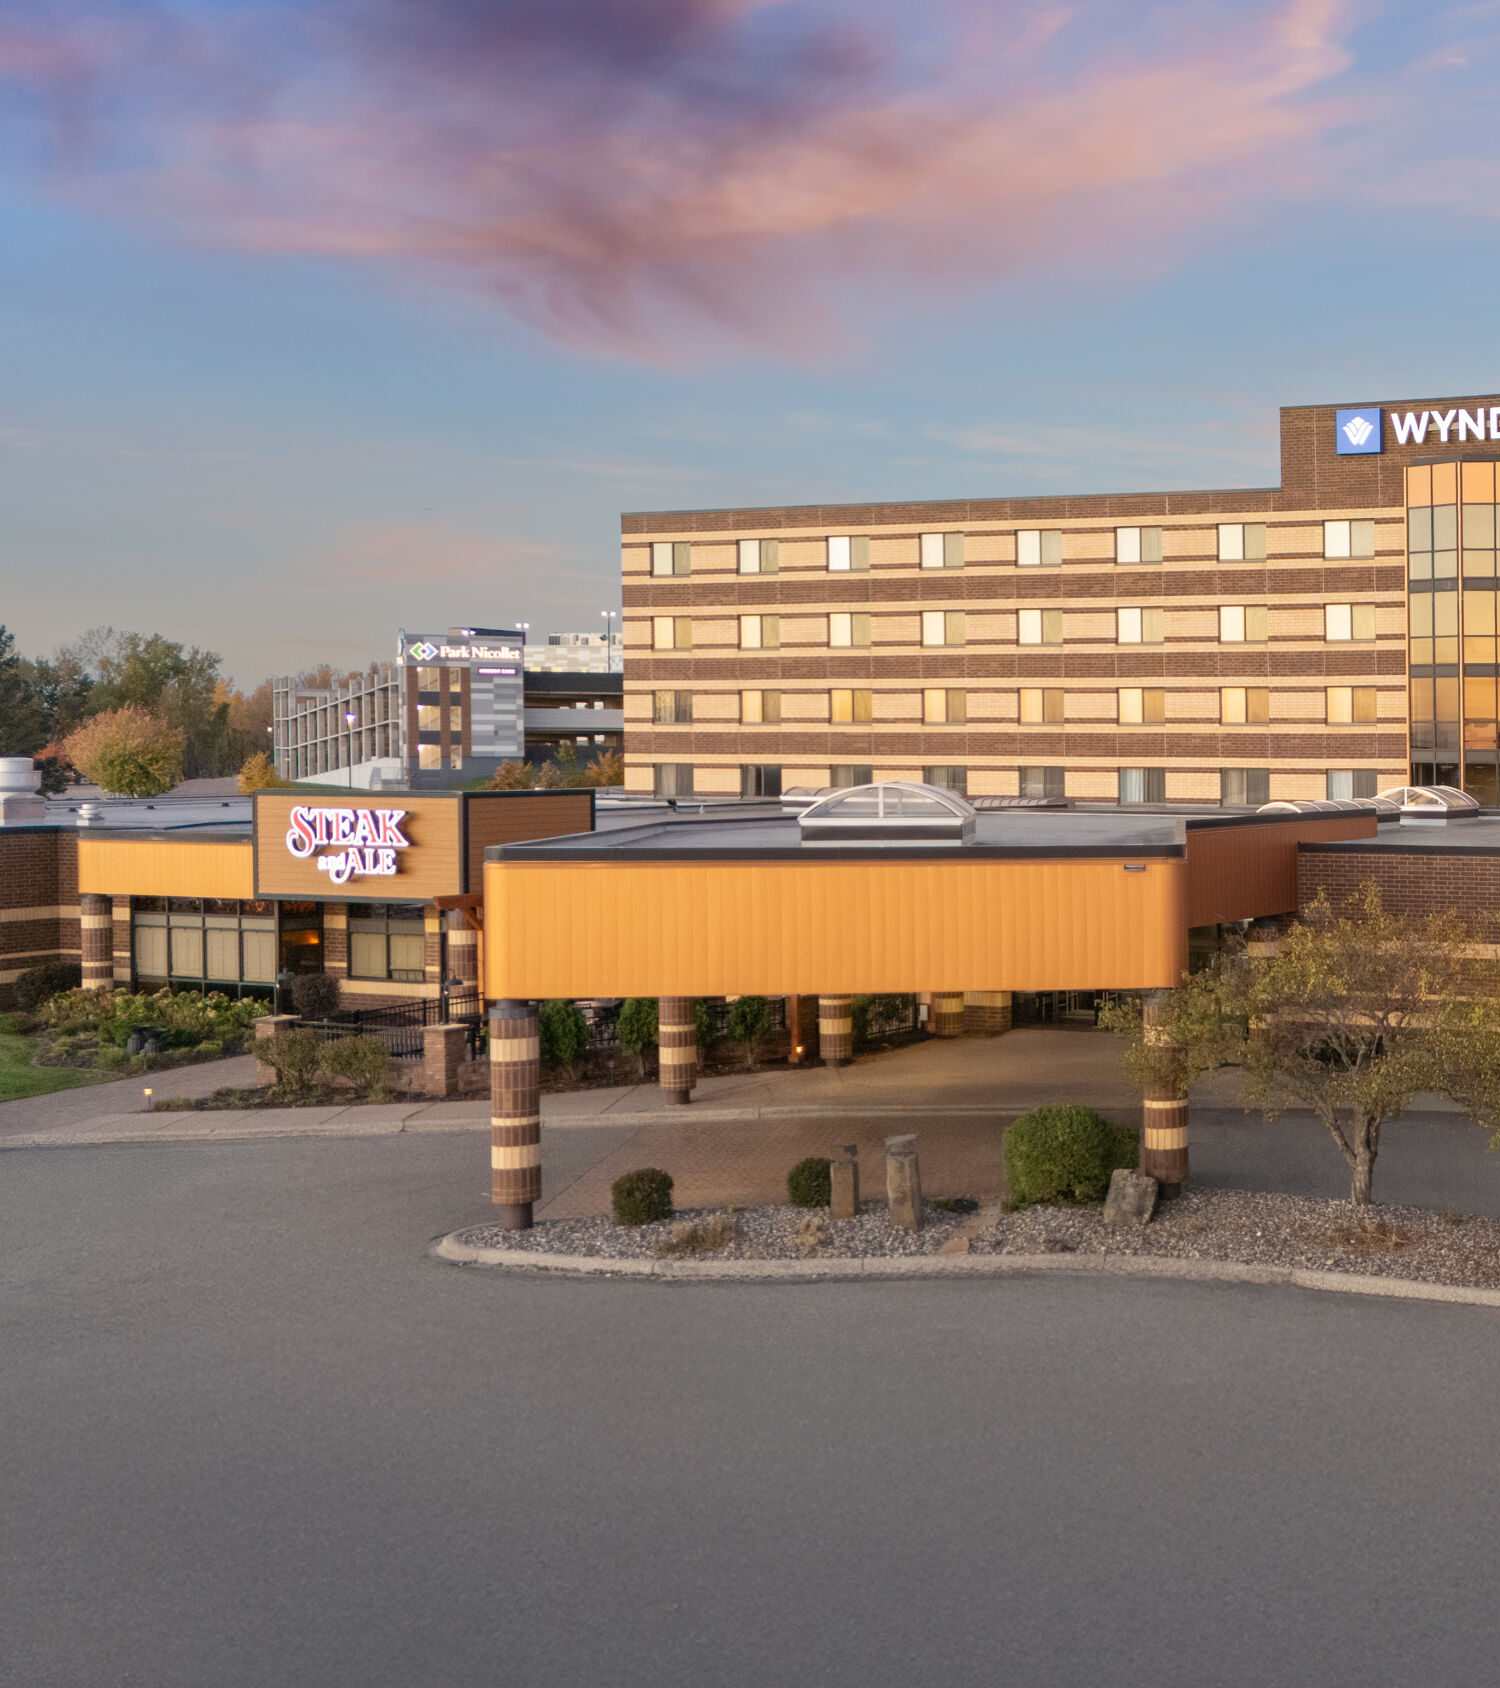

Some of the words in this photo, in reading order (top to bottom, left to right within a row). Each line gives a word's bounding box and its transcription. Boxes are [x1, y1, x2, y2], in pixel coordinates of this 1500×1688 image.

[439, 645, 470, 658] Park
[471, 646, 520, 660] Nicollet
[286, 806, 409, 858] STEAK
[317, 852, 346, 871] and
[329, 847, 397, 884] ALE
